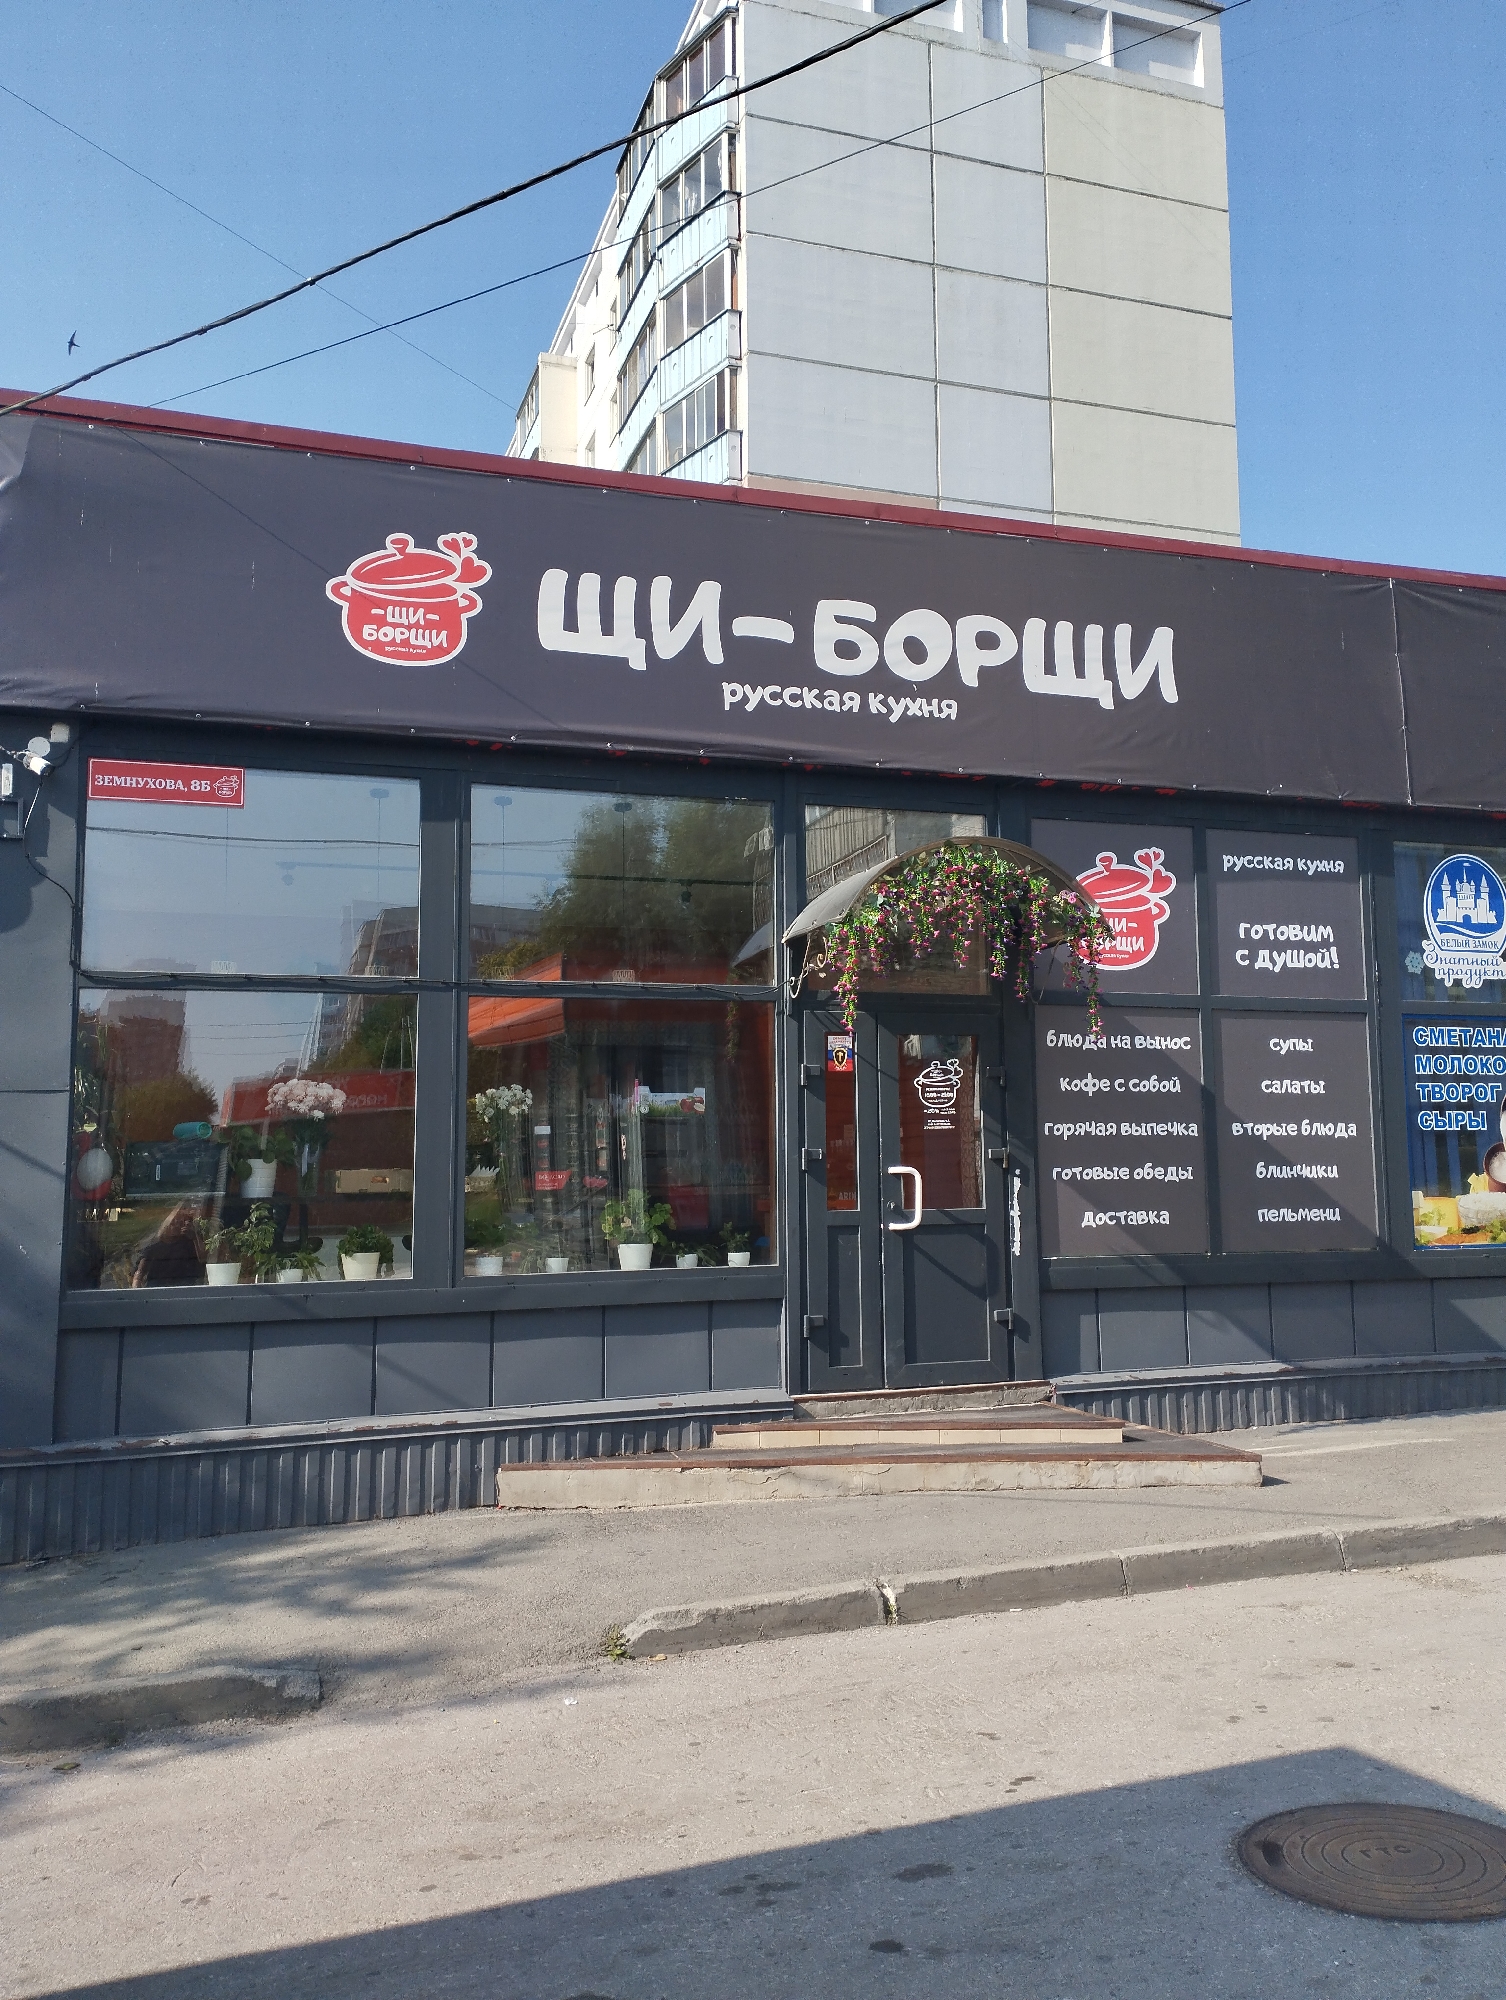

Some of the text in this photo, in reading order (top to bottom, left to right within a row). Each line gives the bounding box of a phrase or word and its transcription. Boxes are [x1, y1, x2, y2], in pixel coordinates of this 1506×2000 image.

[362, 624, 448, 649] БОРЩИ
[722, 682, 959, 724] русская кухня
[94, 775, 188, 792] ЗЕМНУХОВА,
[190, 780, 211, 792] 8Б
[1222, 854, 1345, 876] русская кухня
[1238, 922, 1334, 943] готовим
[1440, 938, 1500, 950] БЕЛЫЙ ЗАМОК
[1235, 946, 1340, 973] с душой!
[1425, 942, 1503, 967] Знатный
[1437, 967, 1506, 986] продукт
[1046, 1029, 1192, 1051] блюда на вынос
[1269, 1037, 1314, 1055] супы
[1413, 1026, 1506, 1047] СМЕТАН
[1415, 1055, 1506, 1075] МОЛОКО
[1059, 1072, 1182, 1097] кофе с собой
[1260, 1079, 1326, 1095] салаты
[1416, 1083, 1502, 1102] ТВОРОГ
[1044, 1120, 1199, 1140] горячая выпечка
[1231, 1117, 1358, 1140] вторые блюда
[1418, 1111, 1487, 1130] СЫРЫ
[1052, 1162, 1194, 1183] готовые обеды
[1255, 1161, 1339, 1180] блинчики
[1080, 1210, 1170, 1229] доставка
[1257, 1207, 1342, 1224] пельмени
